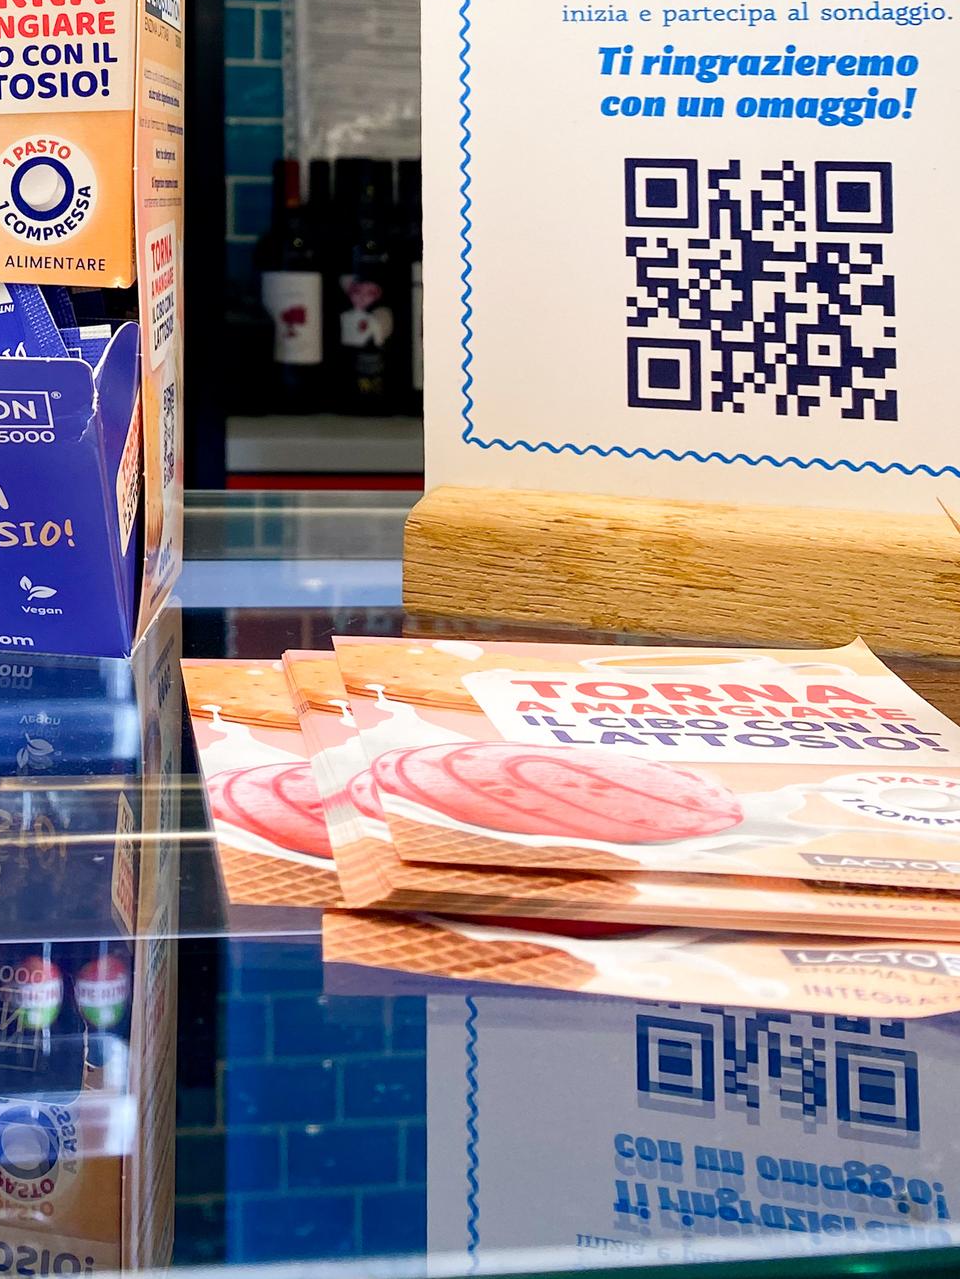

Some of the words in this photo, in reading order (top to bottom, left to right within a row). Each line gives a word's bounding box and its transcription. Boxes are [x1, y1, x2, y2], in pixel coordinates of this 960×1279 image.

[22, 43, 83, 66] CON
[93, 42, 118, 63] IL
[598, 45, 633, 75] Ti
[641, 45, 919, 83] ringrazieremo
[601, 96, 666, 117] con
[677, 97, 724, 117] un
[736, 87, 917, 126] omaggio!
[3, 158, 15, 168] 1
[13, 140, 71, 160] PASTO
[5, 186, 91, 241] COMPRESSA
[5, 255, 105, 271] ALIMENTARE
[21, 606, 62, 615] Vegan
[510, 679, 877, 705] TORNA
[515, 700, 547, 714] A
[571, 701, 918, 721] MANGIARE
[522, 715, 576, 728] IL
[588, 716, 728, 731] CIBO
[743, 719, 870, 735] CON
[881, 722, 942, 737] IL
[550, 729, 950, 753] LATTOSIO!
